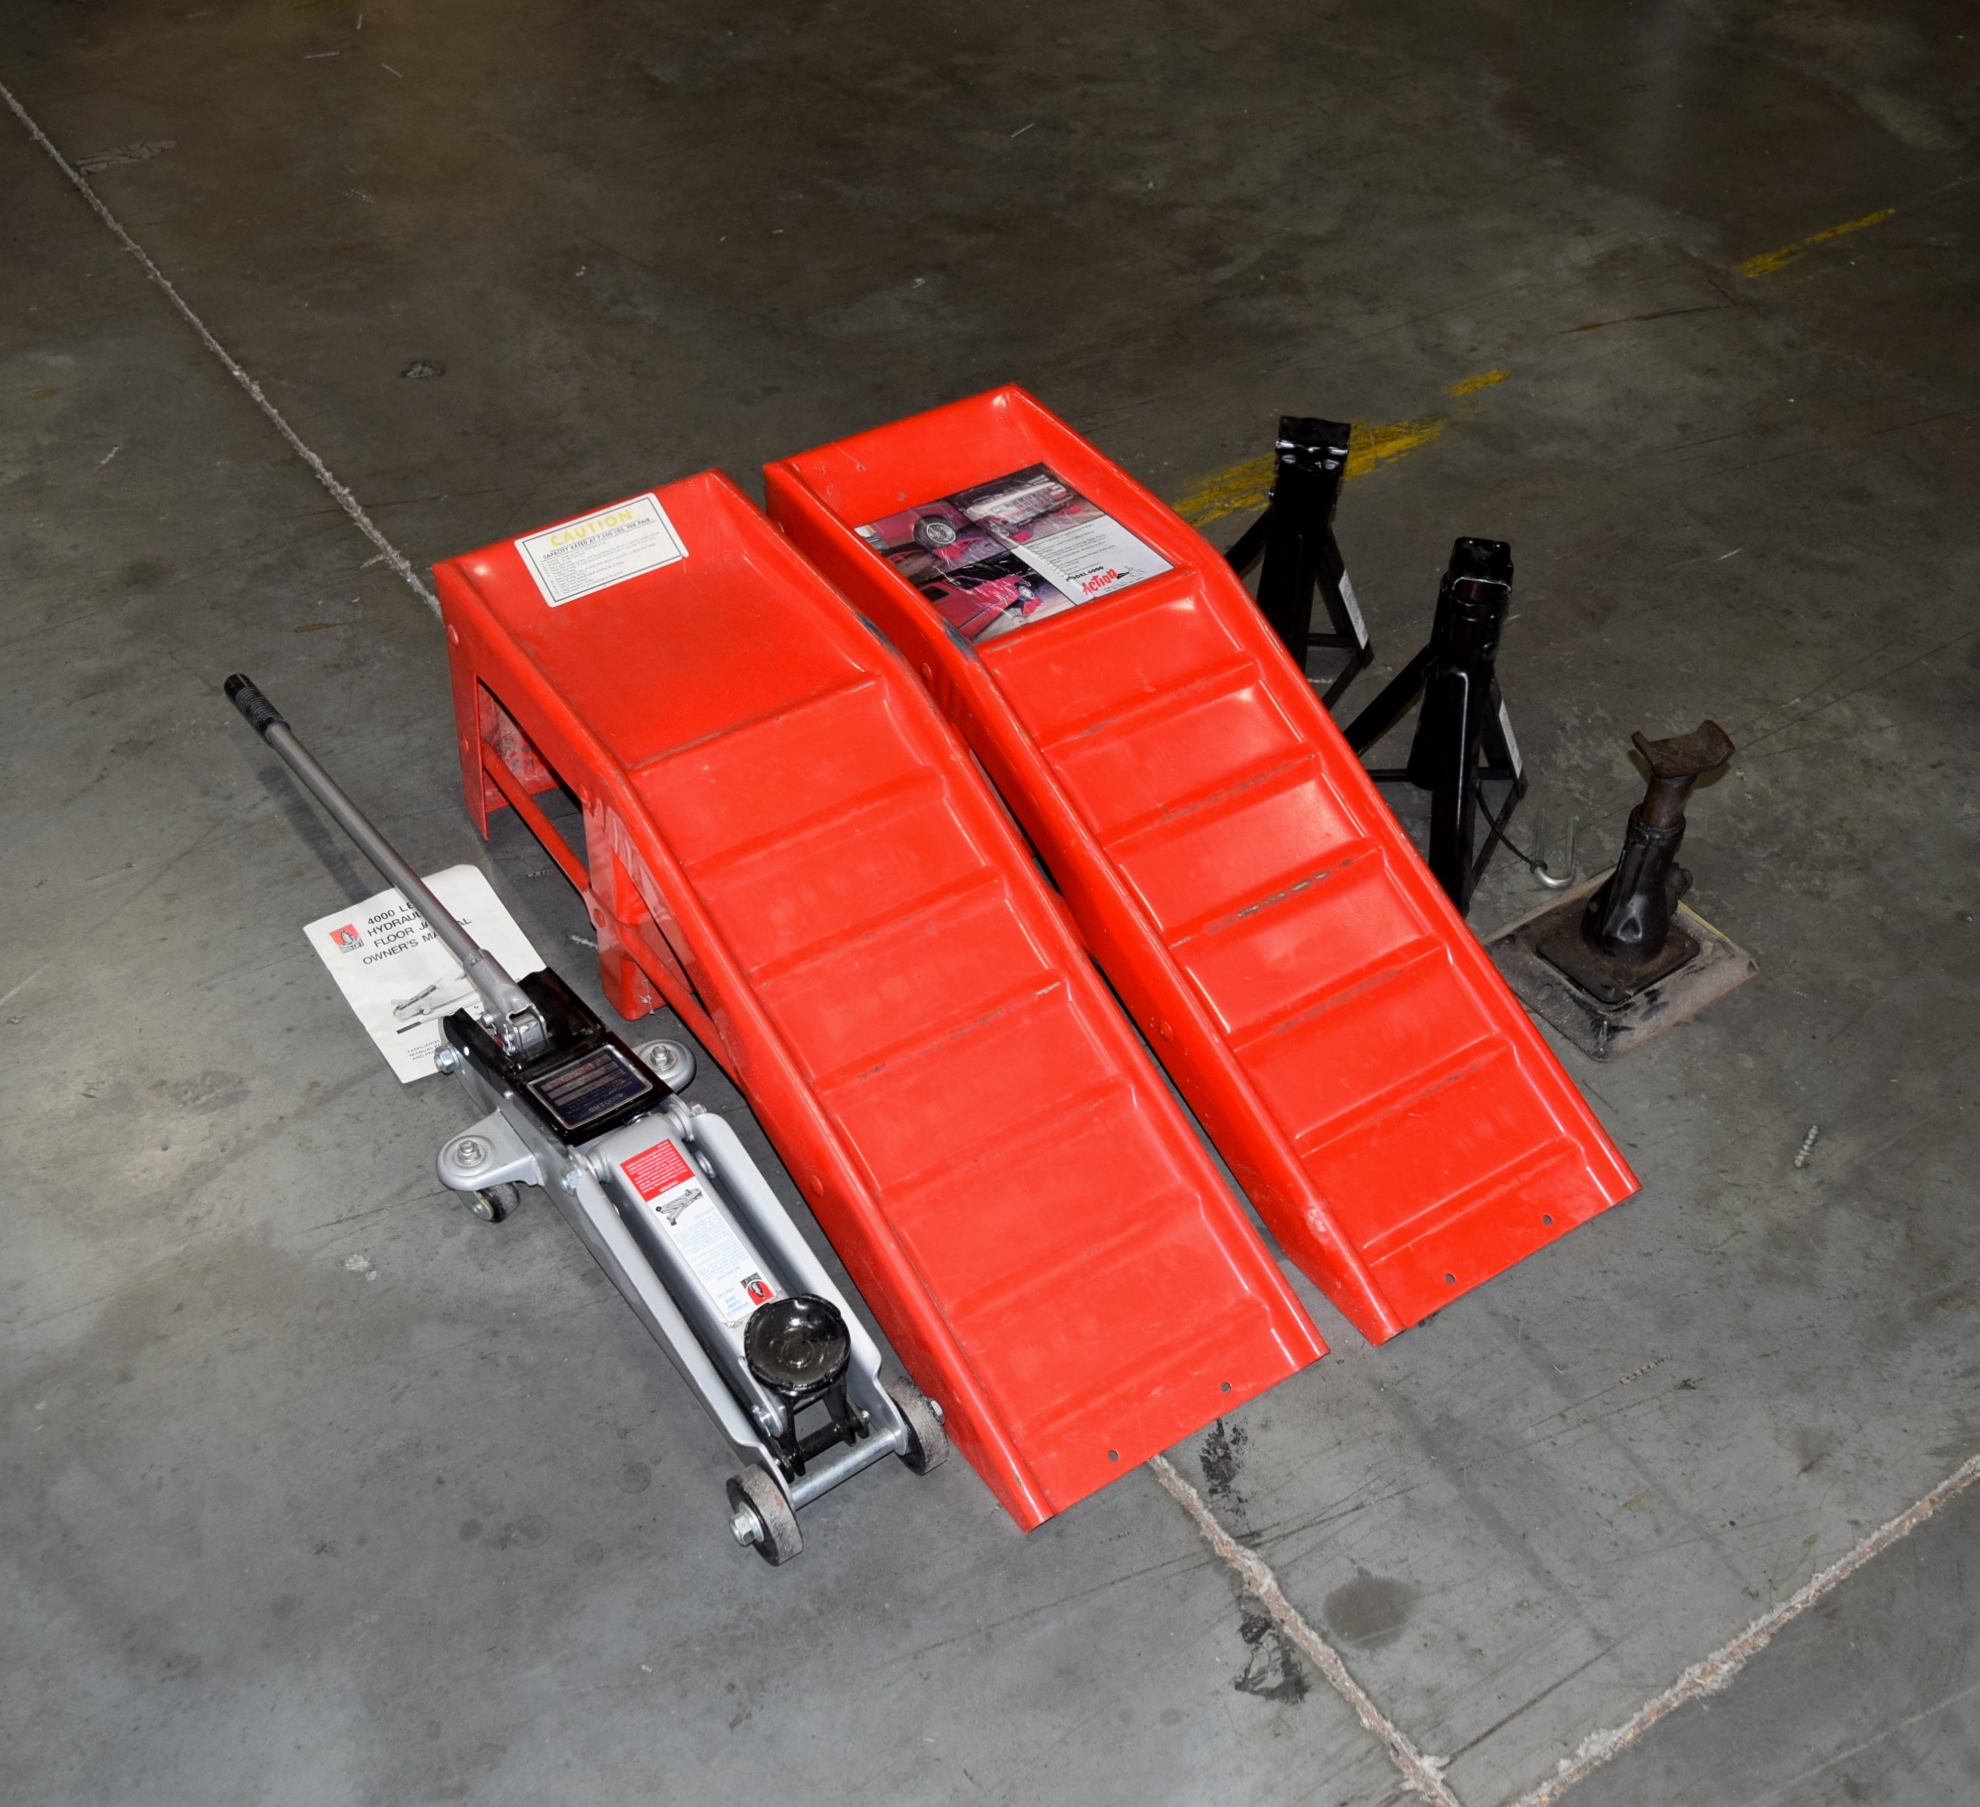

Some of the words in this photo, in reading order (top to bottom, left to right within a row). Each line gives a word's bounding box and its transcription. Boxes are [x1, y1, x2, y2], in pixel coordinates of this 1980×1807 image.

[550, 509, 633, 547] CAUTION
[543, 547, 569, 560] CAPACITY
[570, 541, 588, 550] RATED
[367, 909, 395, 925] 4000
[367, 911, 422, 937] HYDRAUL
[374, 927, 415, 948] FLOOR
[362, 939, 419, 965] OWNER'S
[604, 1093, 624, 1104] 4000
